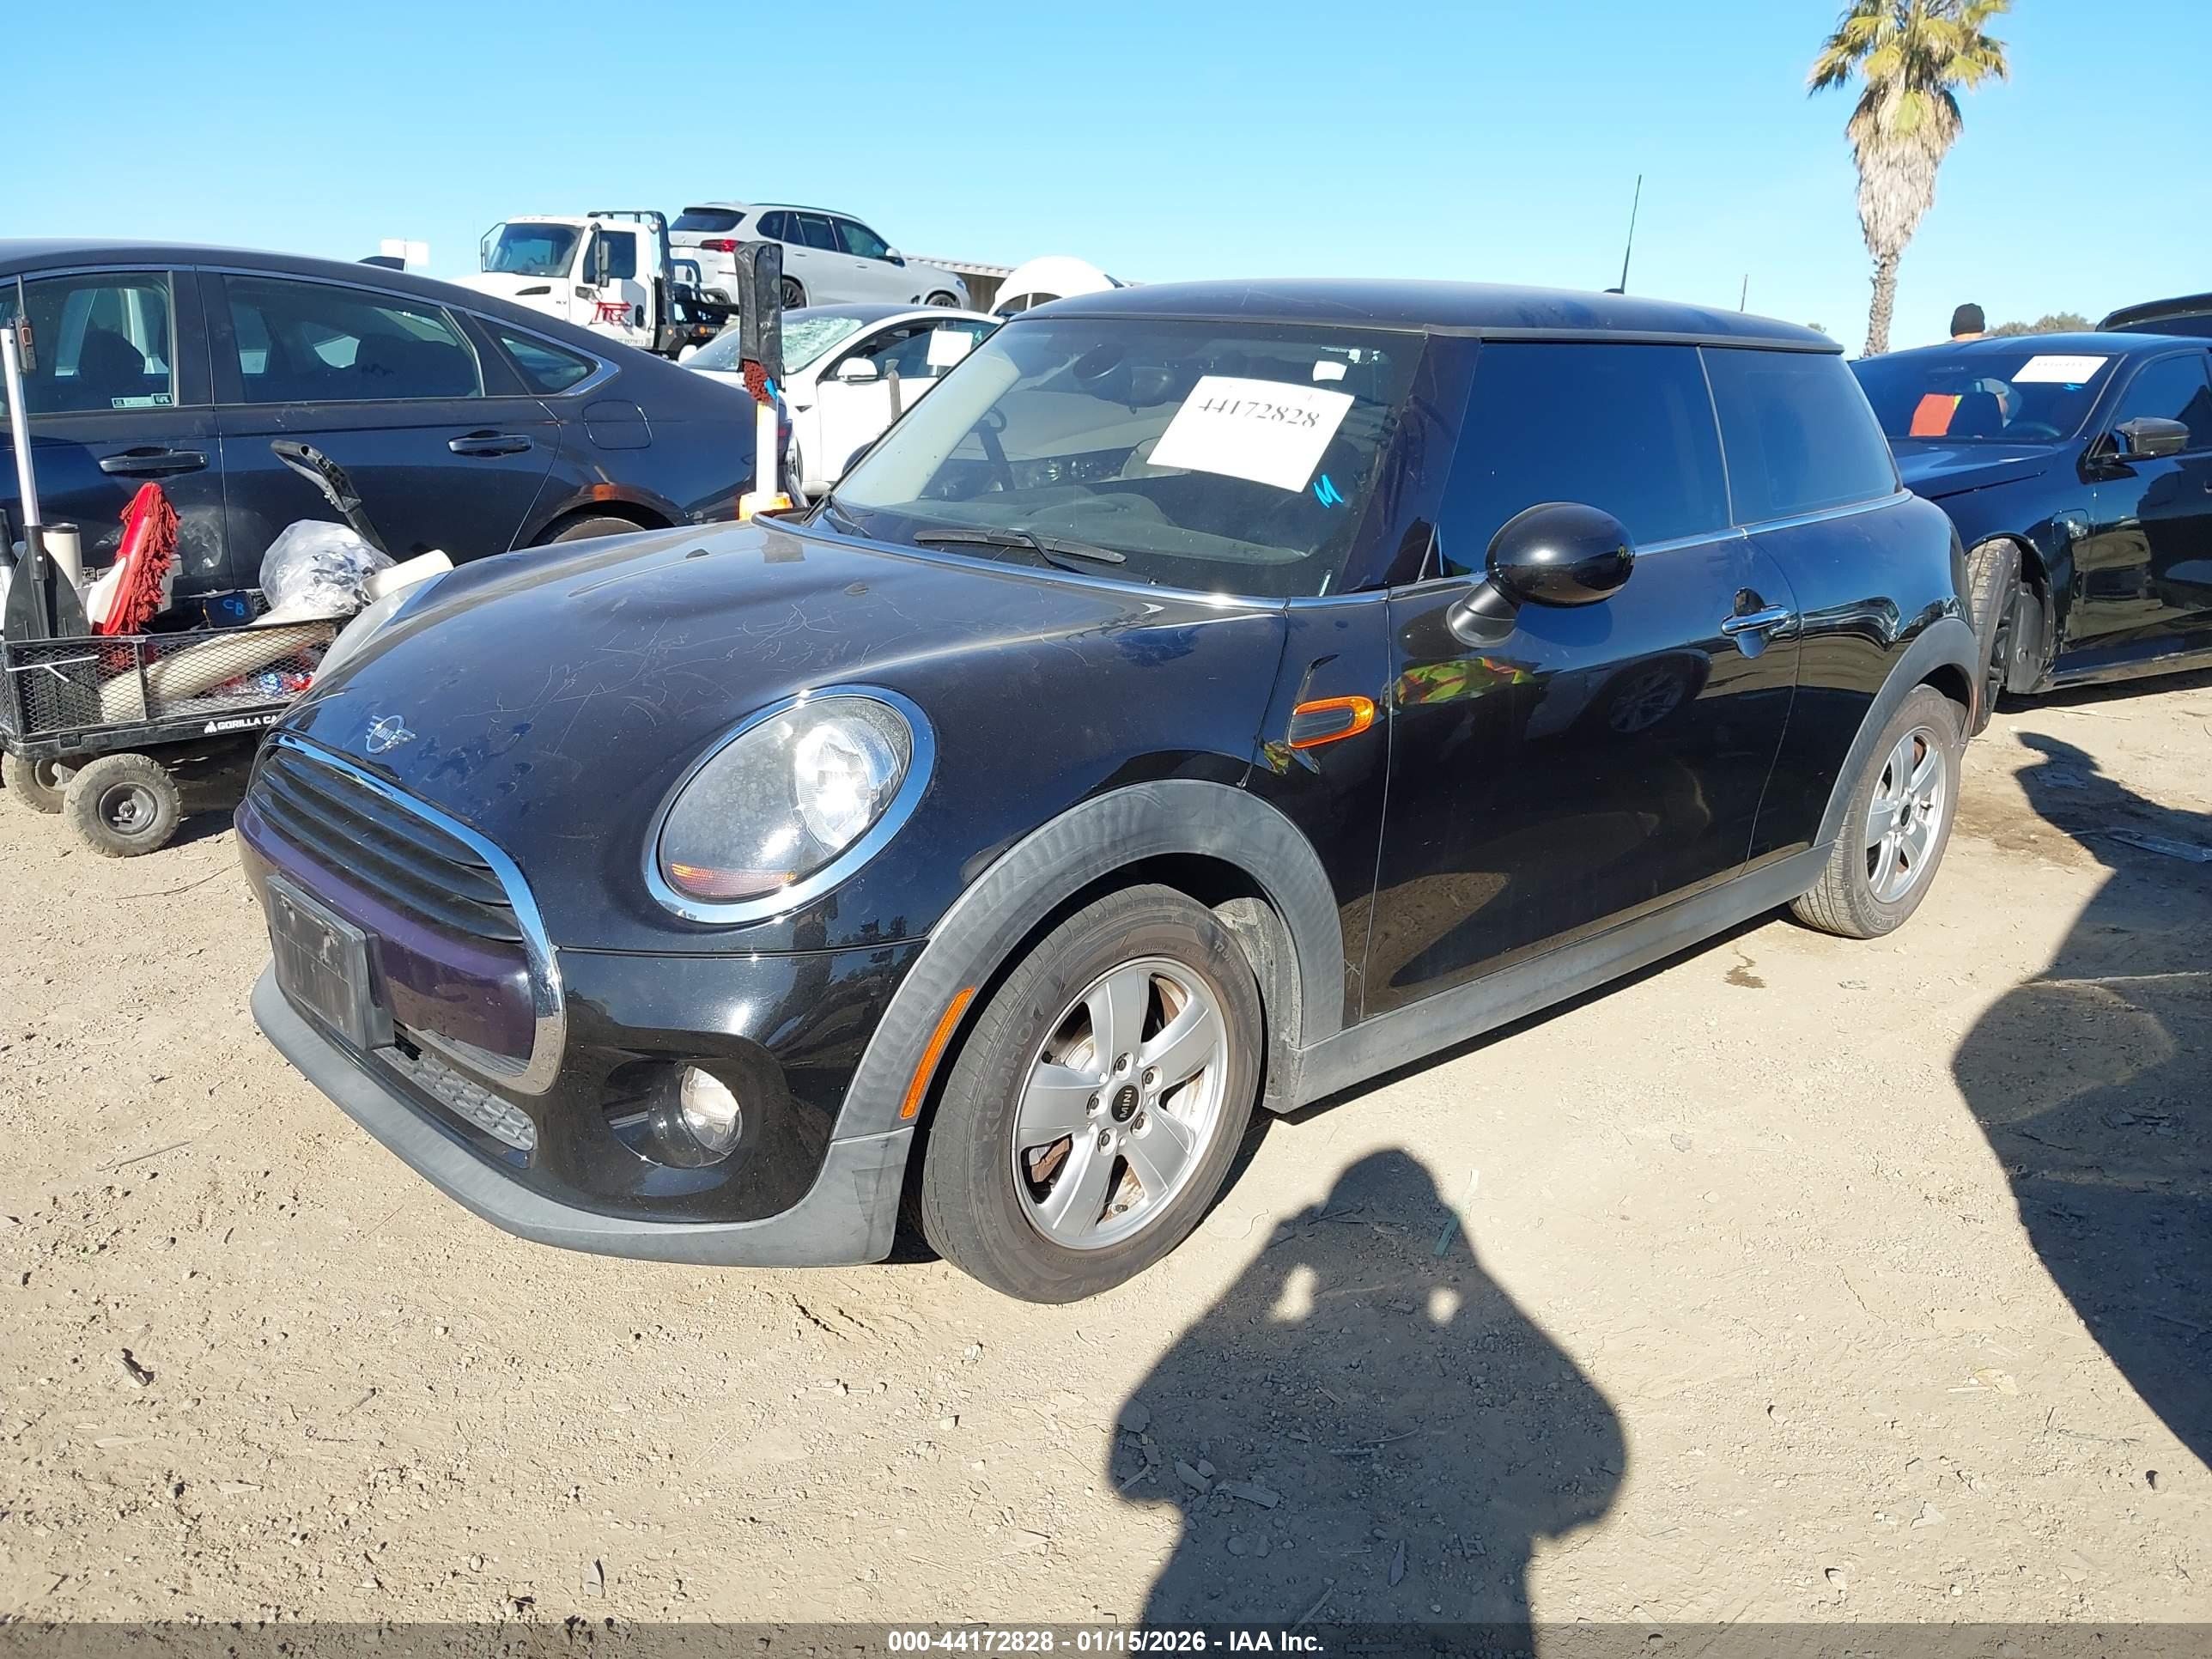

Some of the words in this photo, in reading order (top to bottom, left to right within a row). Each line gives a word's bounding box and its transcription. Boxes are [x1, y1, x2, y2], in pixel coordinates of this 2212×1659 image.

[1198, 398, 1321, 428] 44172828
[217, 717, 261, 730] GORILLA
[1119, 1089, 1133, 1118] MINI
